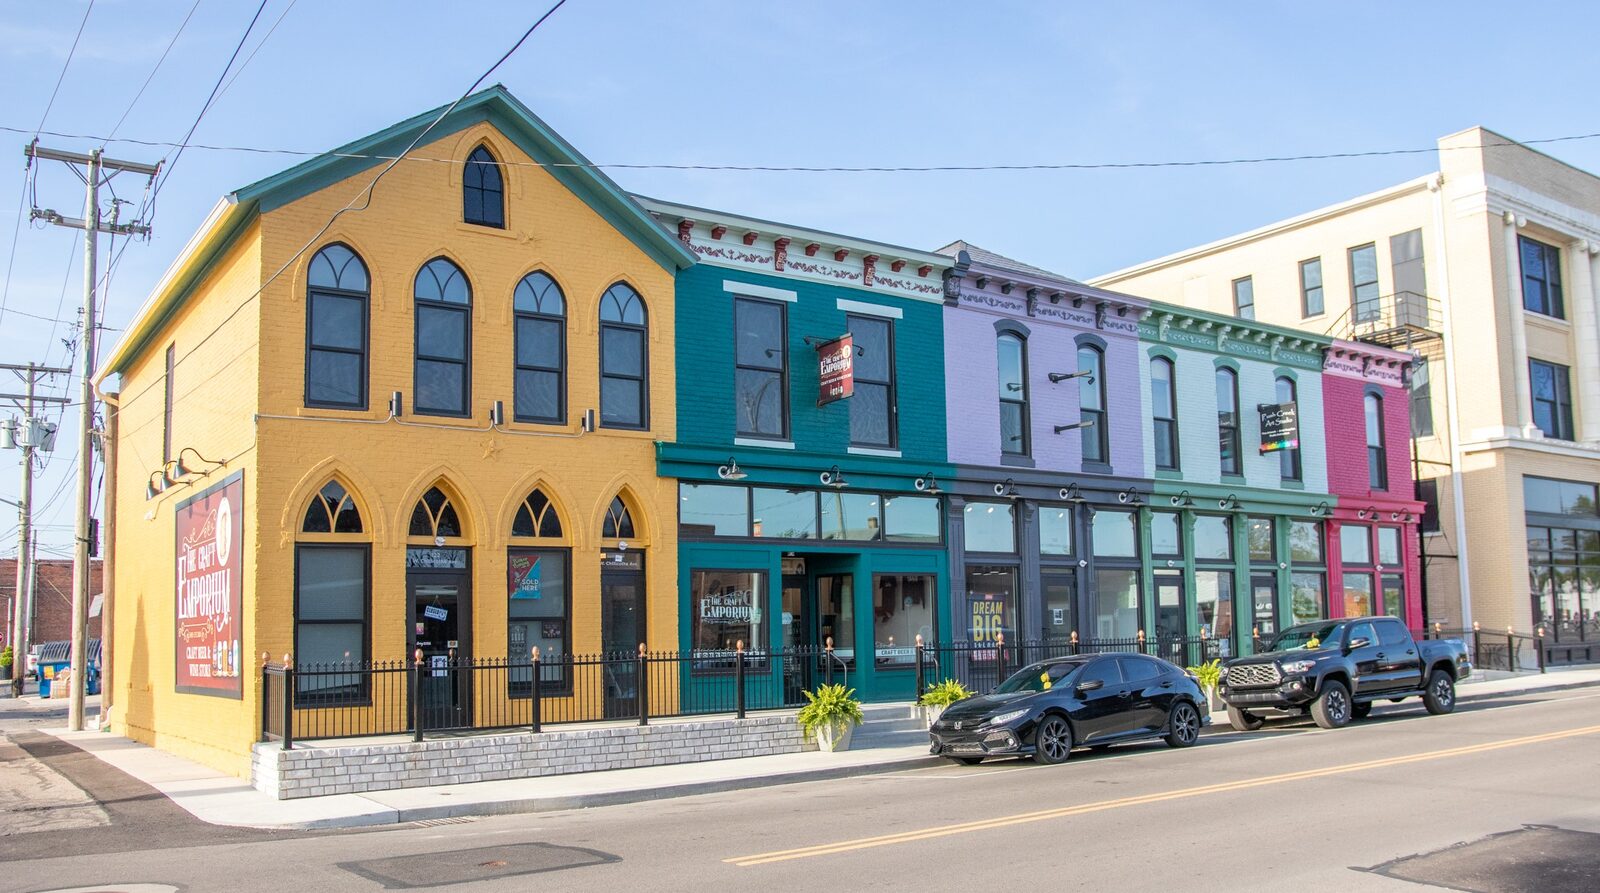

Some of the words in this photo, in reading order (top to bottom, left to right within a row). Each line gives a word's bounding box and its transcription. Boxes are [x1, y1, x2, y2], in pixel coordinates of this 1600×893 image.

[178, 556, 231, 630] EMPORIUM
[711, 597, 721, 606] THE
[723, 598, 742, 606] CRAFT
[973, 601, 1003, 615] DREAM
[973, 614, 1003, 642] BIG
